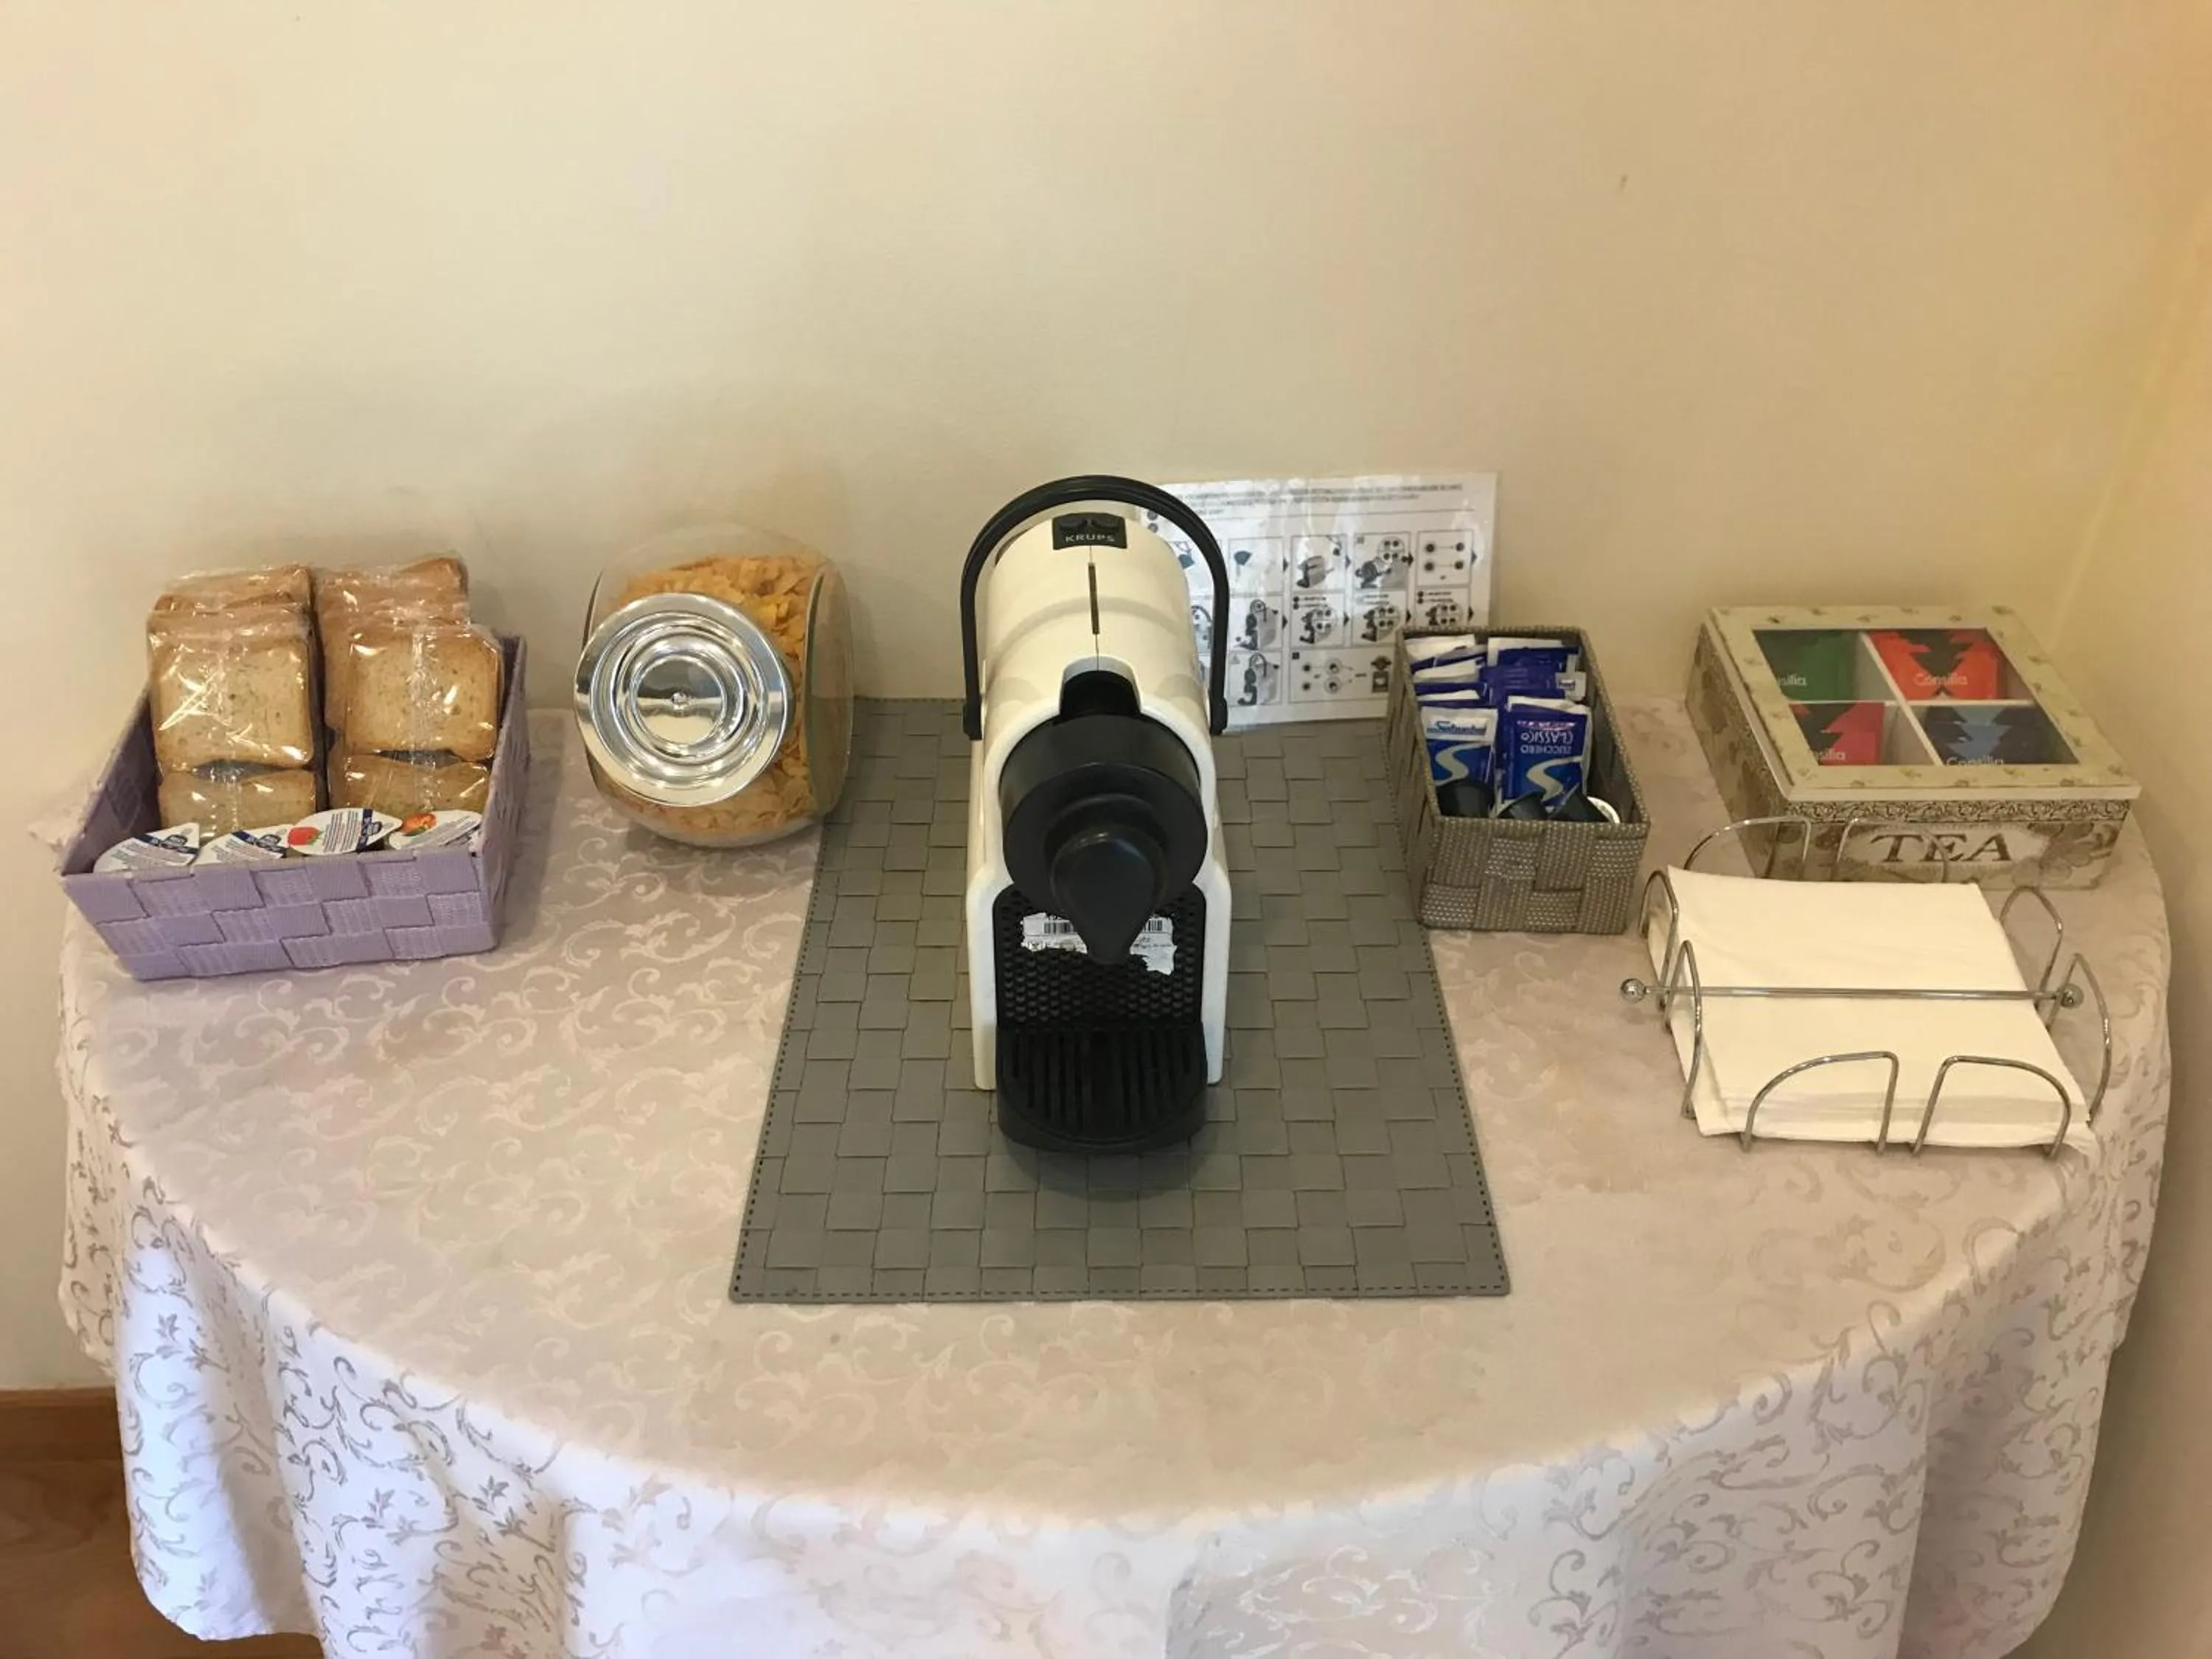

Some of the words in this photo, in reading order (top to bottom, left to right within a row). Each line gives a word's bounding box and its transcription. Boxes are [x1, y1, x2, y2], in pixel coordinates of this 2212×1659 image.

[1065, 533, 1116, 543] KRUPS
[1521, 731, 1573, 745] CLASSICO
[1870, 833, 2011, 863] TEA
